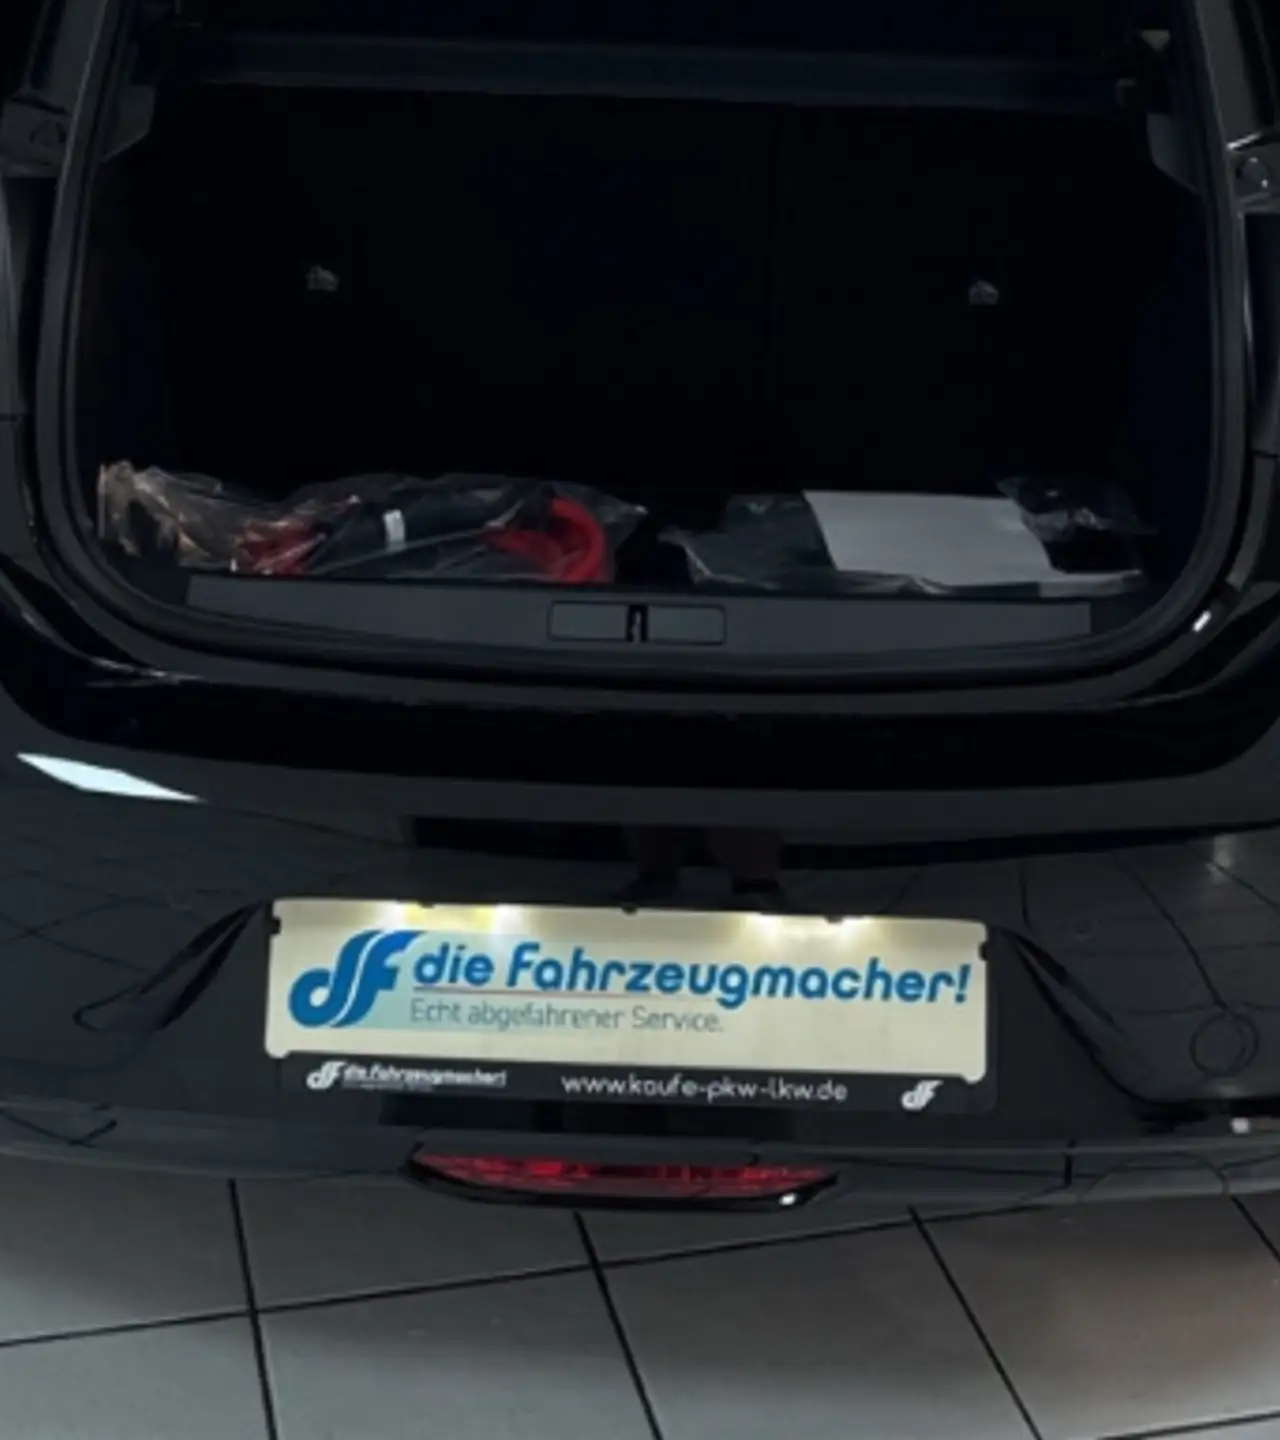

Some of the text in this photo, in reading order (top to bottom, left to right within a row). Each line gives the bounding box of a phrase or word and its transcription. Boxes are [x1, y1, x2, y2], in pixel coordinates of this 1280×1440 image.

[413, 942, 971, 1009] die Fahrzeugmacher!
[411, 998, 461, 1023] Echt
[468, 1000, 625, 1031] abgefahrener
[561, 1073, 848, 1103] www.kaufe-pkw-lkw.de
